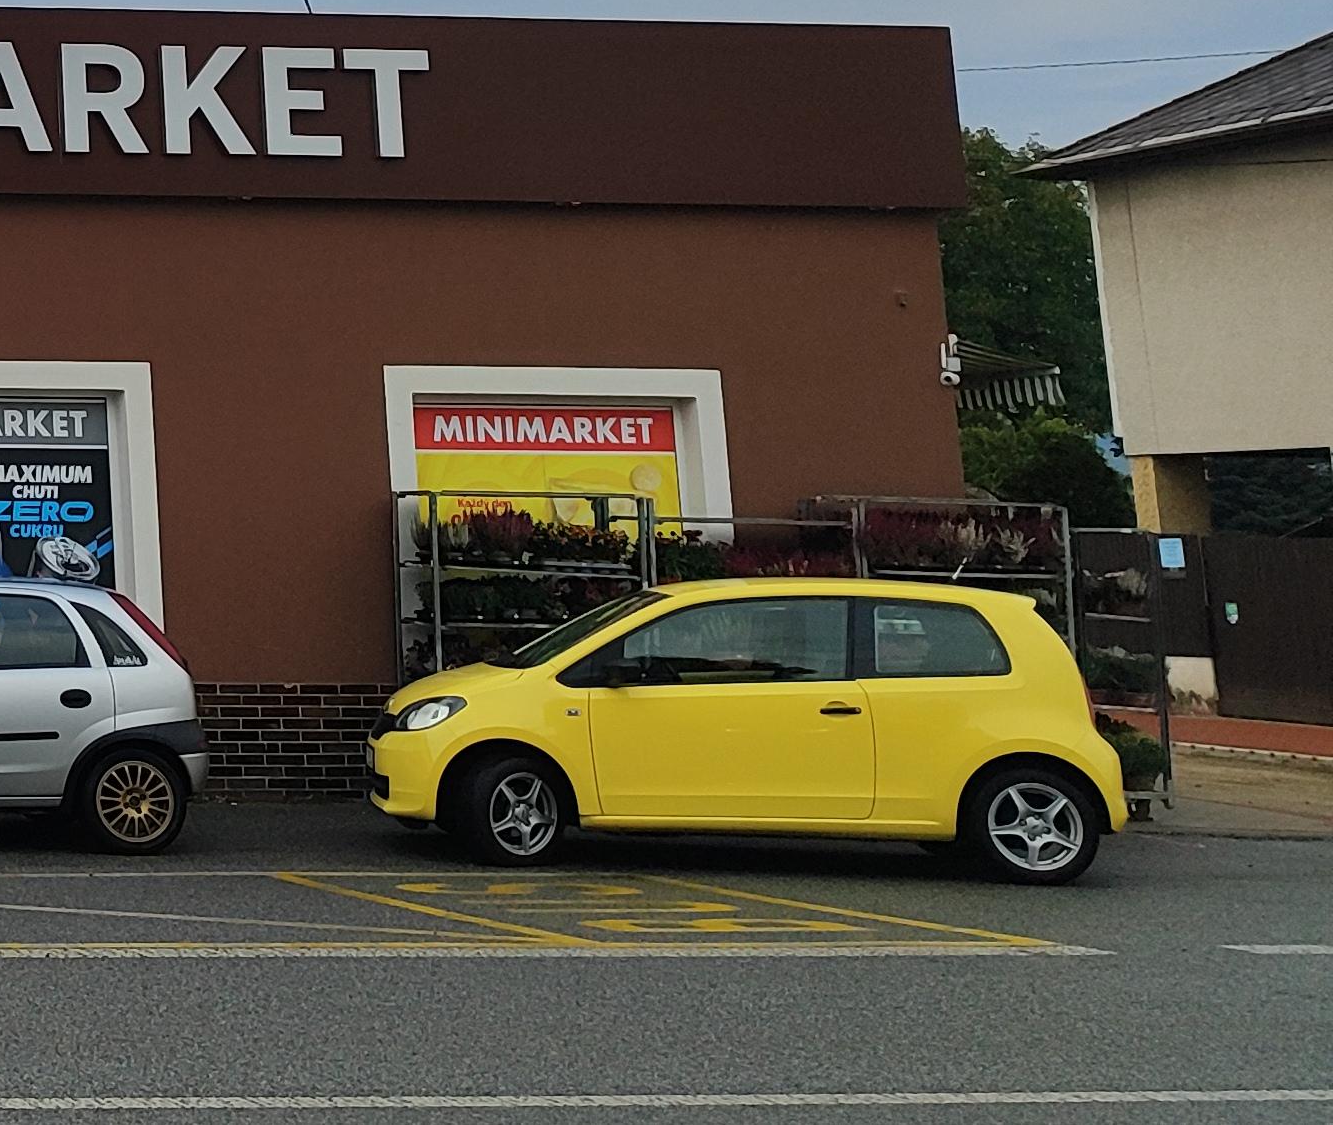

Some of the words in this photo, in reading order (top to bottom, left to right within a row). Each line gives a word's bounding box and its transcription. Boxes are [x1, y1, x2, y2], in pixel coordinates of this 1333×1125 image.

[433, 415, 654, 444] MINIMARKET
[12, 485, 59, 499] CHUTI
[9, 524, 64, 538] CUKRU
